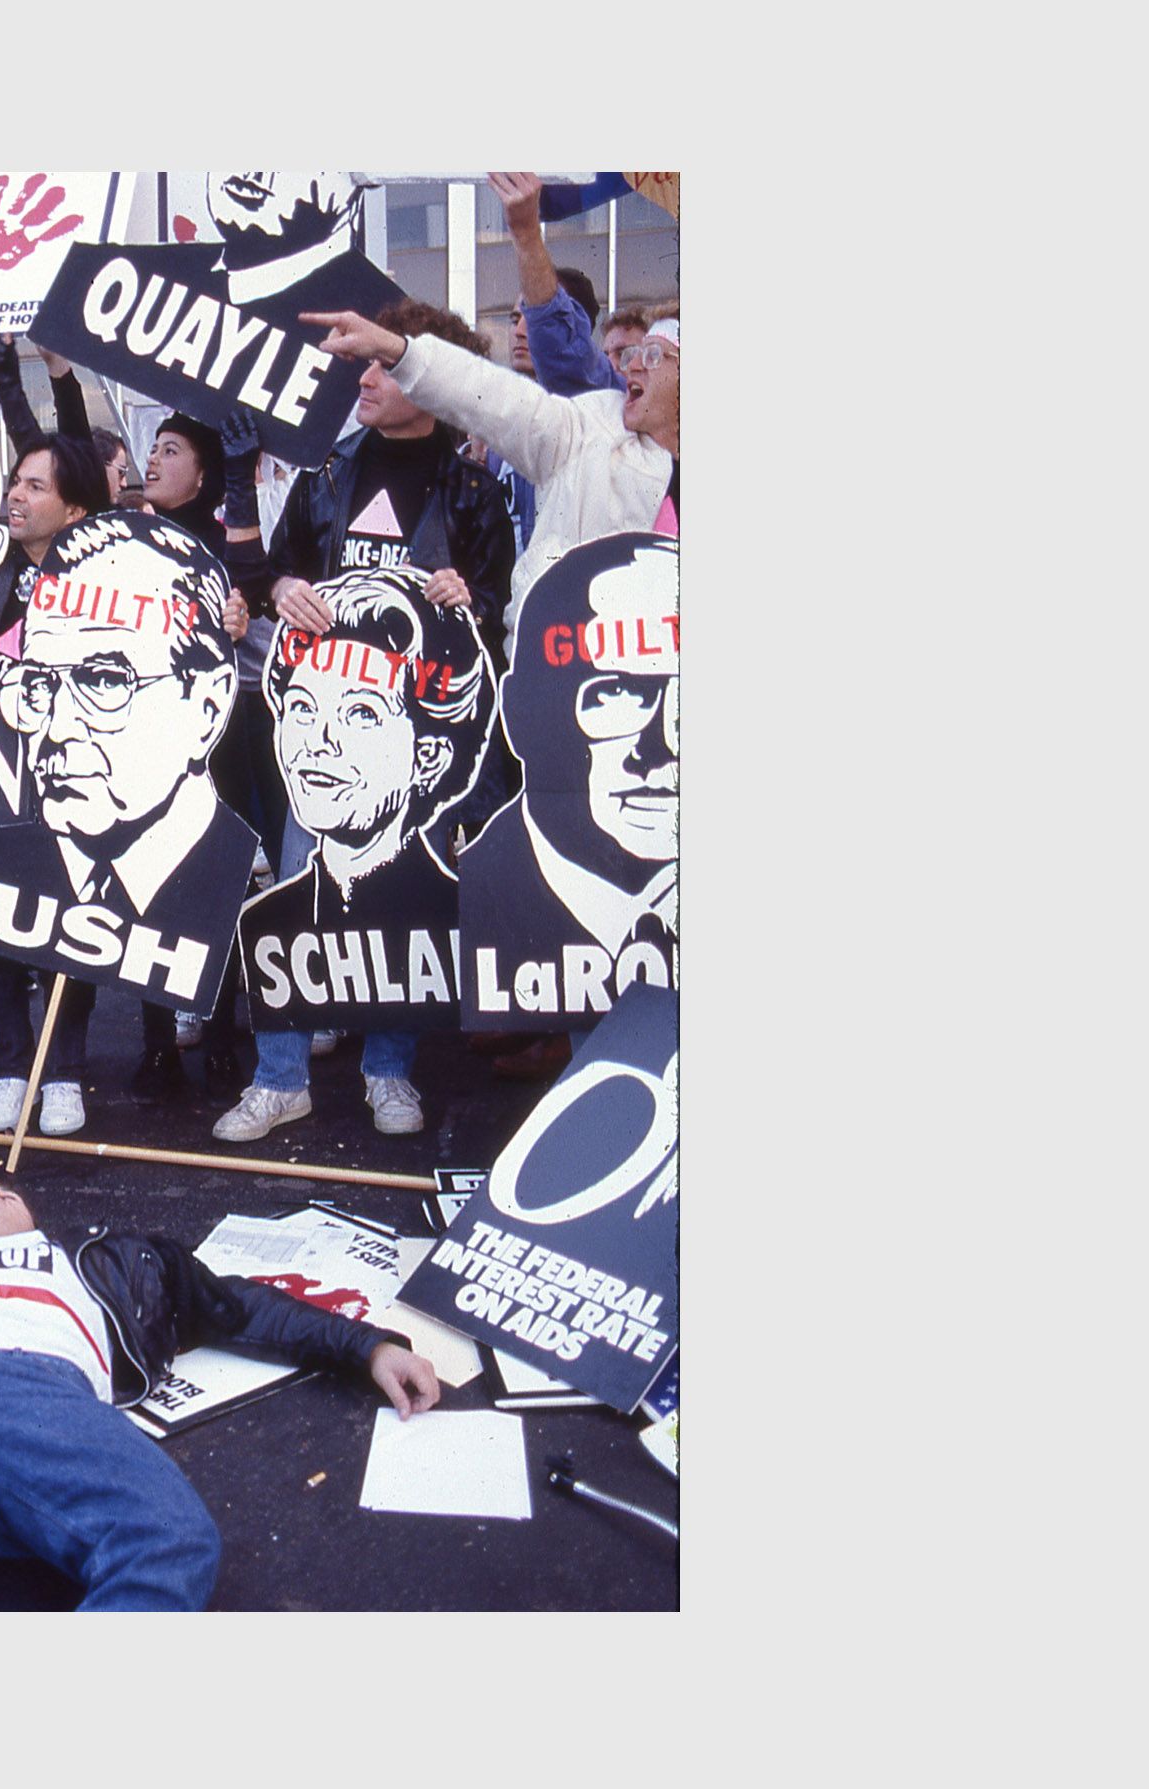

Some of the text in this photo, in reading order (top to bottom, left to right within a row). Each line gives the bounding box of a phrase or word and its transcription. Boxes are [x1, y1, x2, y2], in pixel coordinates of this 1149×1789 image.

[82, 257, 334, 428] QUAYLE
[33, 574, 199, 637] GUILTY!
[282, 629, 453, 701] GUILTY!
[254, 930, 461, 1009] SCHLA
[476, 941, 679, 1012] LaRO
[0, 1241, 51, 1271] UP
[467, 1221, 664, 1326] THE FEDERAL
[431, 1238, 668, 1362] INTEREST RATE
[455, 1283, 591, 1361] ON AIDS
